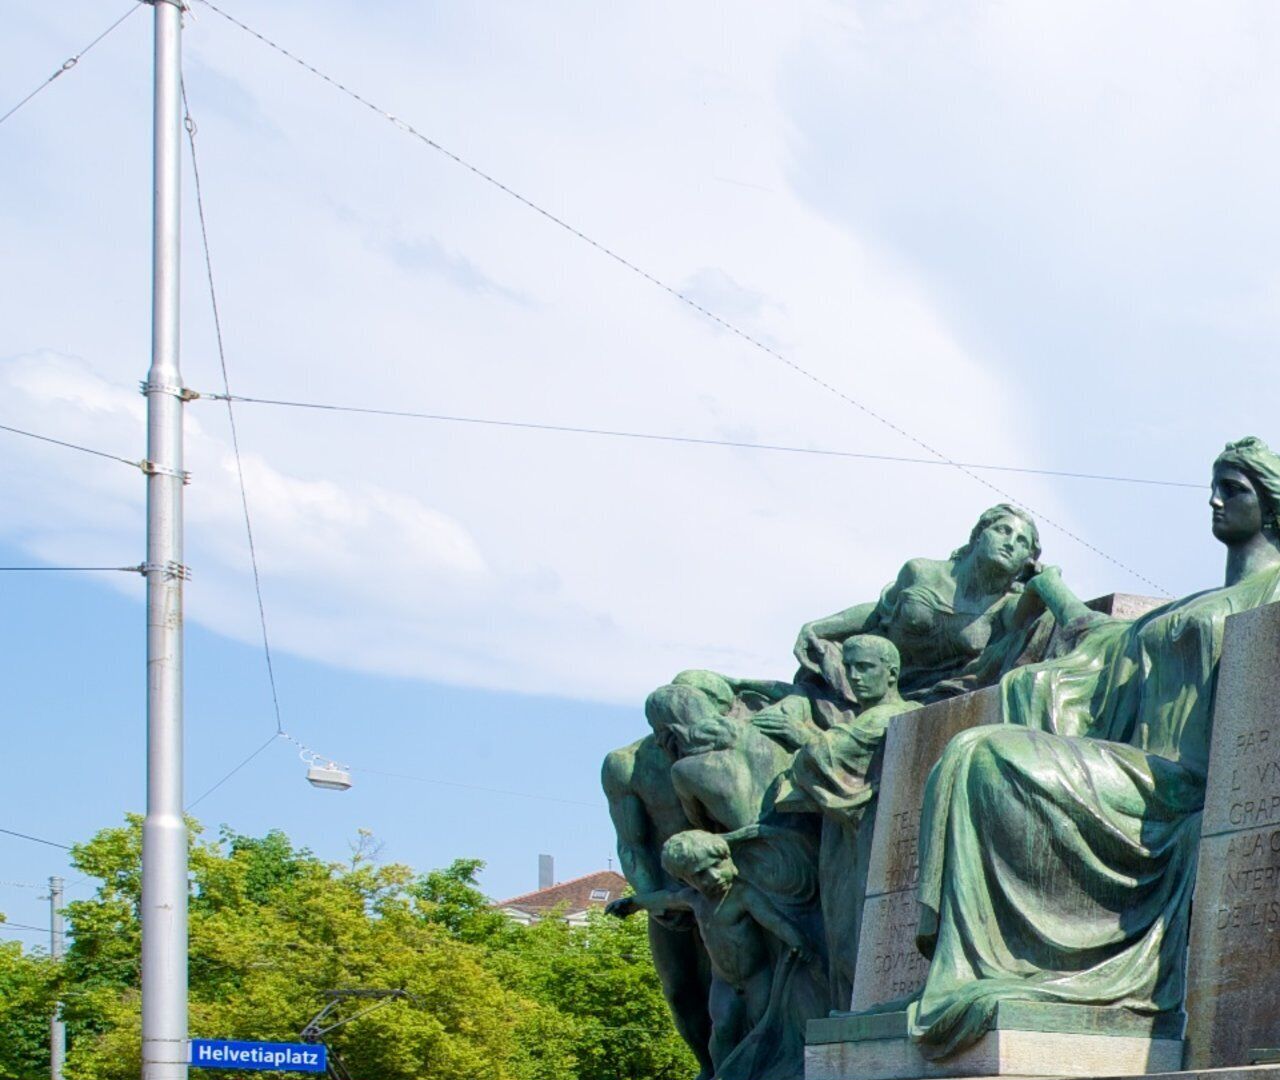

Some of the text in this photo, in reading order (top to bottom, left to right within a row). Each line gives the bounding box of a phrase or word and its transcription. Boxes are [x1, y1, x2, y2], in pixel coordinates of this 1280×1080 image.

[1235, 730, 1270, 757] PAR
[1217, 907, 1242, 930] DE
[199, 1045, 318, 1067] Helvetiaplatz
